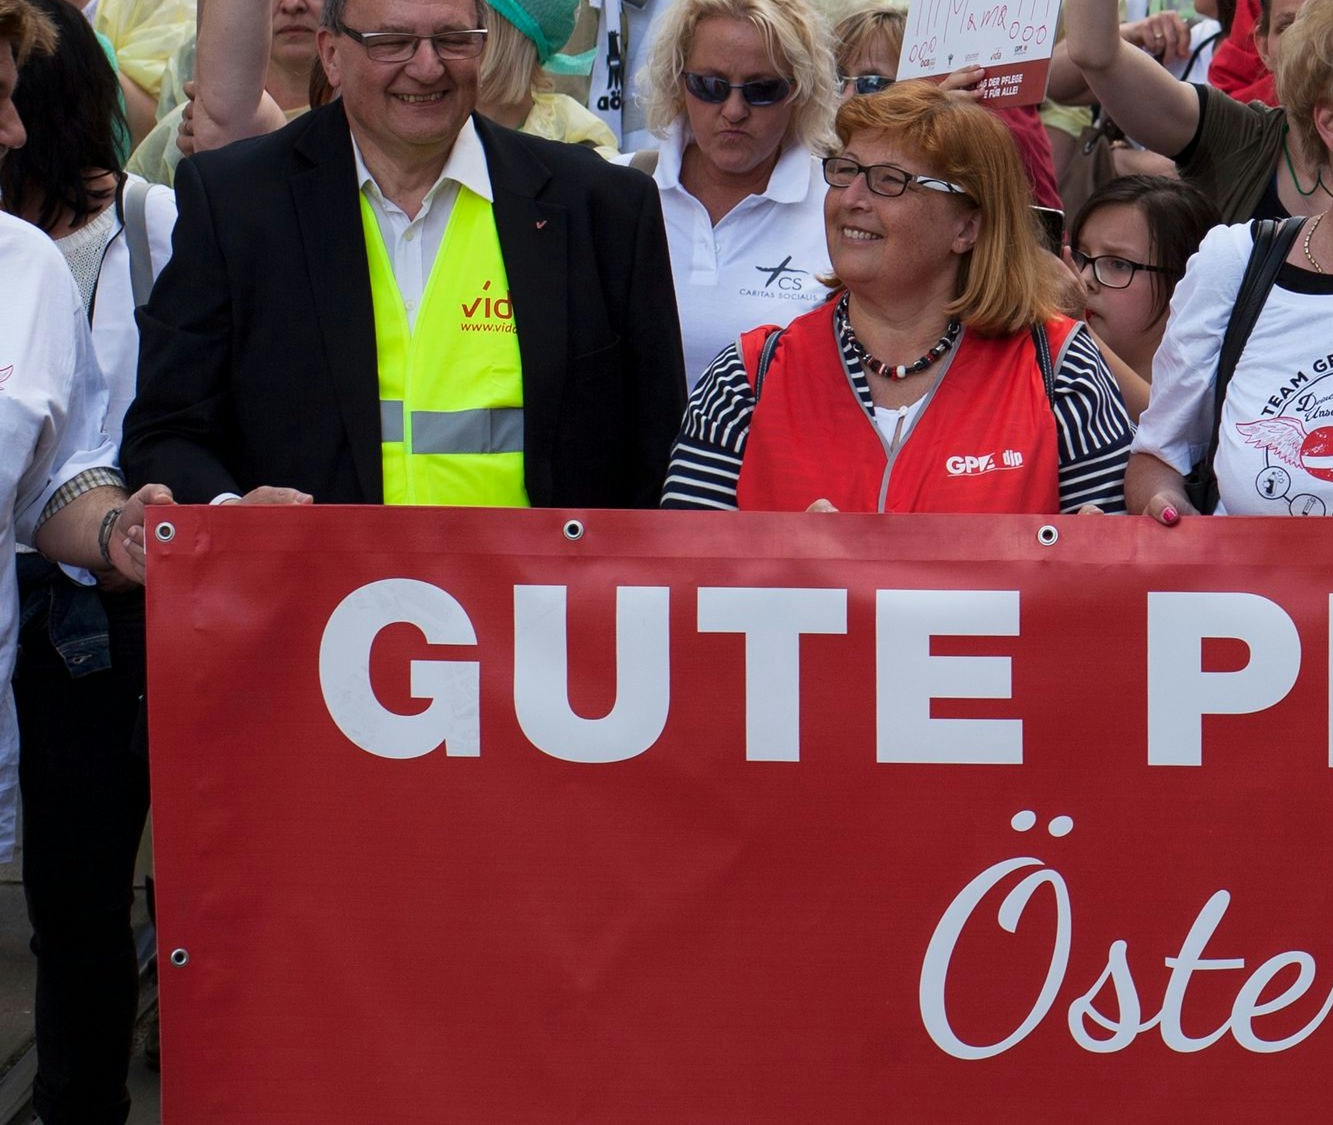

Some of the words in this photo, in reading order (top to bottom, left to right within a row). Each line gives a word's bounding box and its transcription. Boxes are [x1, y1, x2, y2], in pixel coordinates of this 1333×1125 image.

[778, 276, 802, 291] CS
[739, 288, 776, 299] CARITAS
[778, 292, 819, 301] SOCIALIS
[1261, 371, 1309, 417] TEAM
[1002, 449, 1024, 467] djp
[319, 578, 1023, 765] GUTE
